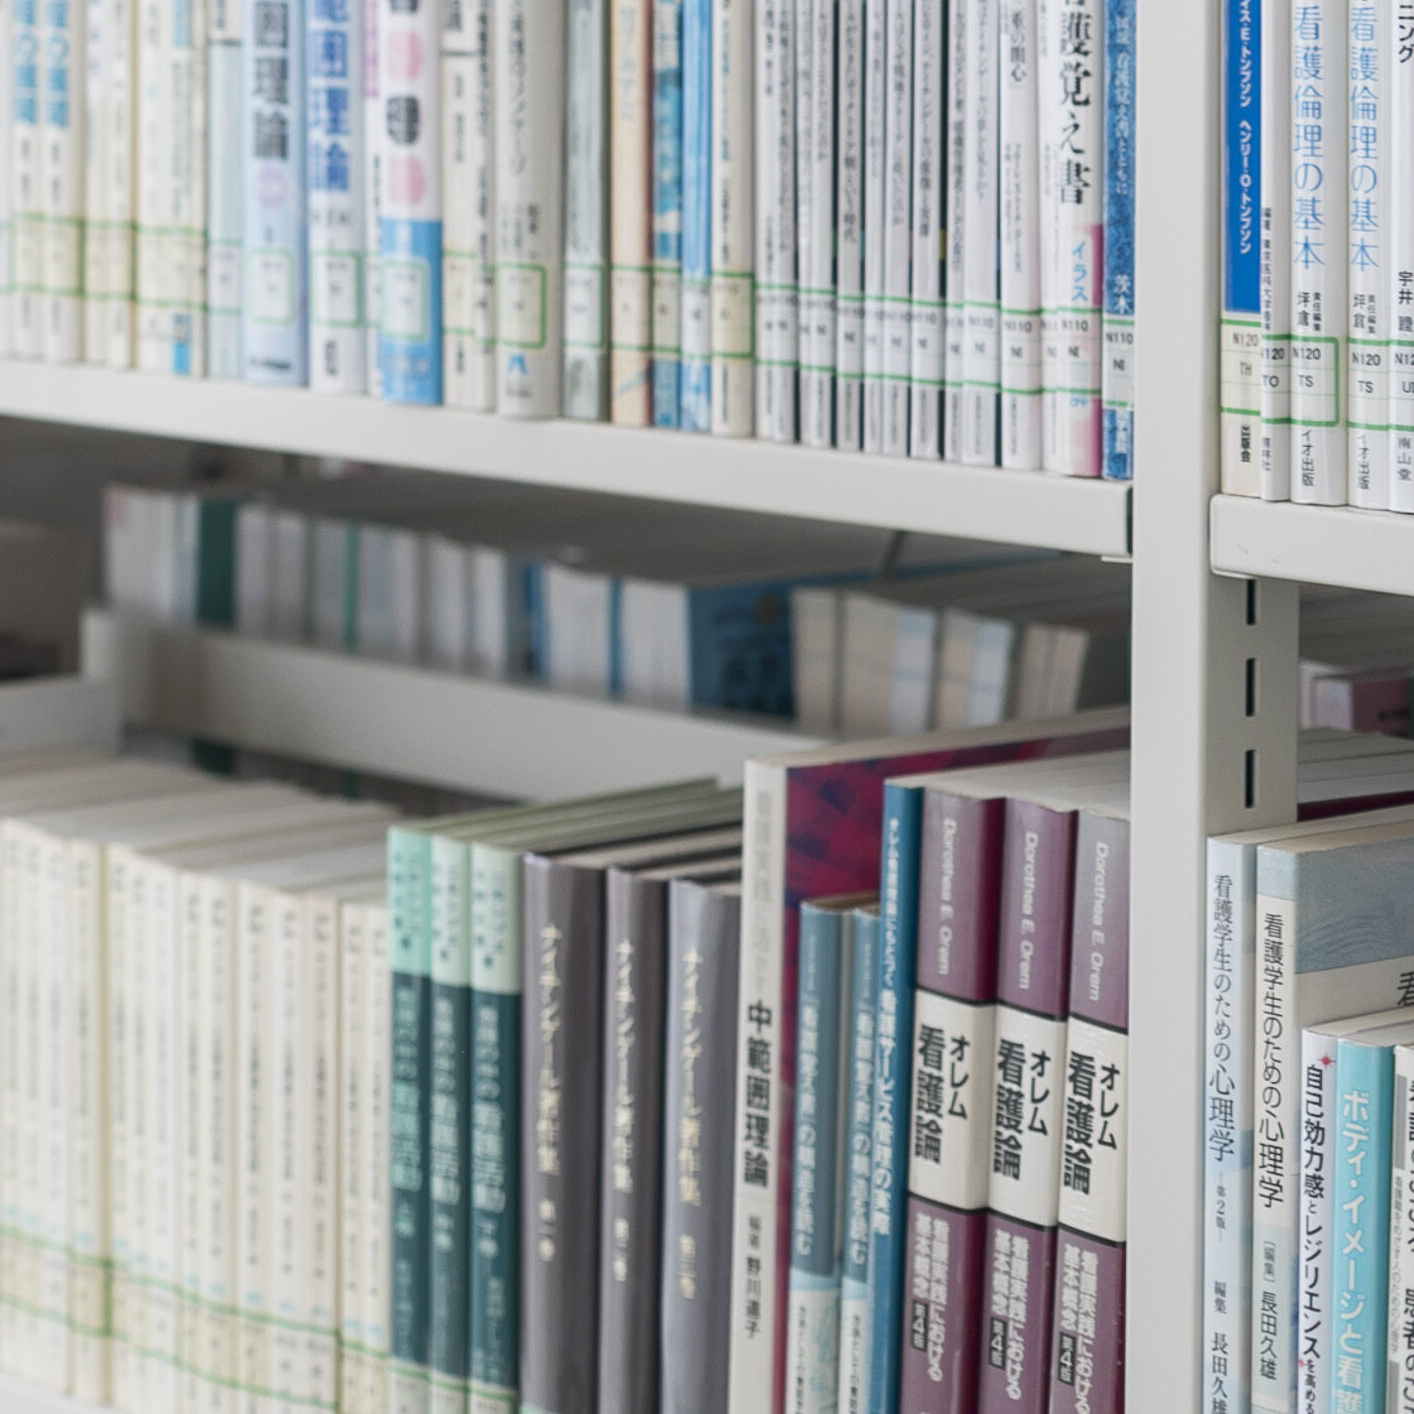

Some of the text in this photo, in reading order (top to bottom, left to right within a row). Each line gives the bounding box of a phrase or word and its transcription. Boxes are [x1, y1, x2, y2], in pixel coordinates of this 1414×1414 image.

[1293, 4, 1325, 270] 看護倫理の基本
[1350, 6, 1380, 272] 看護倫理の基本
[1105, 332, 1135, 346] N110
[1292, 347, 1321, 361] N120
[1352, 351, 1381, 367] N120
[1359, 380, 1374, 394] TS
[940, 817, 957, 901] Dorothea
[1021, 831, 1039, 916] Dorothea
[1091, 842, 1109, 927] Dorothea
[936, 926, 954, 976] Orem
[1017, 940, 1035, 990] Orem
[1087, 951, 1105, 1002] Orem
[1209, 874, 1237, 1163] 看護学生のための心理学
[1258, 913, 1286, 1209] 看護学生のための心理学
[914, 1025, 946, 1165] 看護論
[949, 1036, 970, 1120] オレム
[993, 1039, 1027, 1180] 看護論
[1029, 1050, 1051, 1137] オレム
[1097, 1063, 1121, 1151] オレム
[1062, 1052, 1097, 1196] 看護論
[1259, 1290, 1278, 1381] 長田久雄
